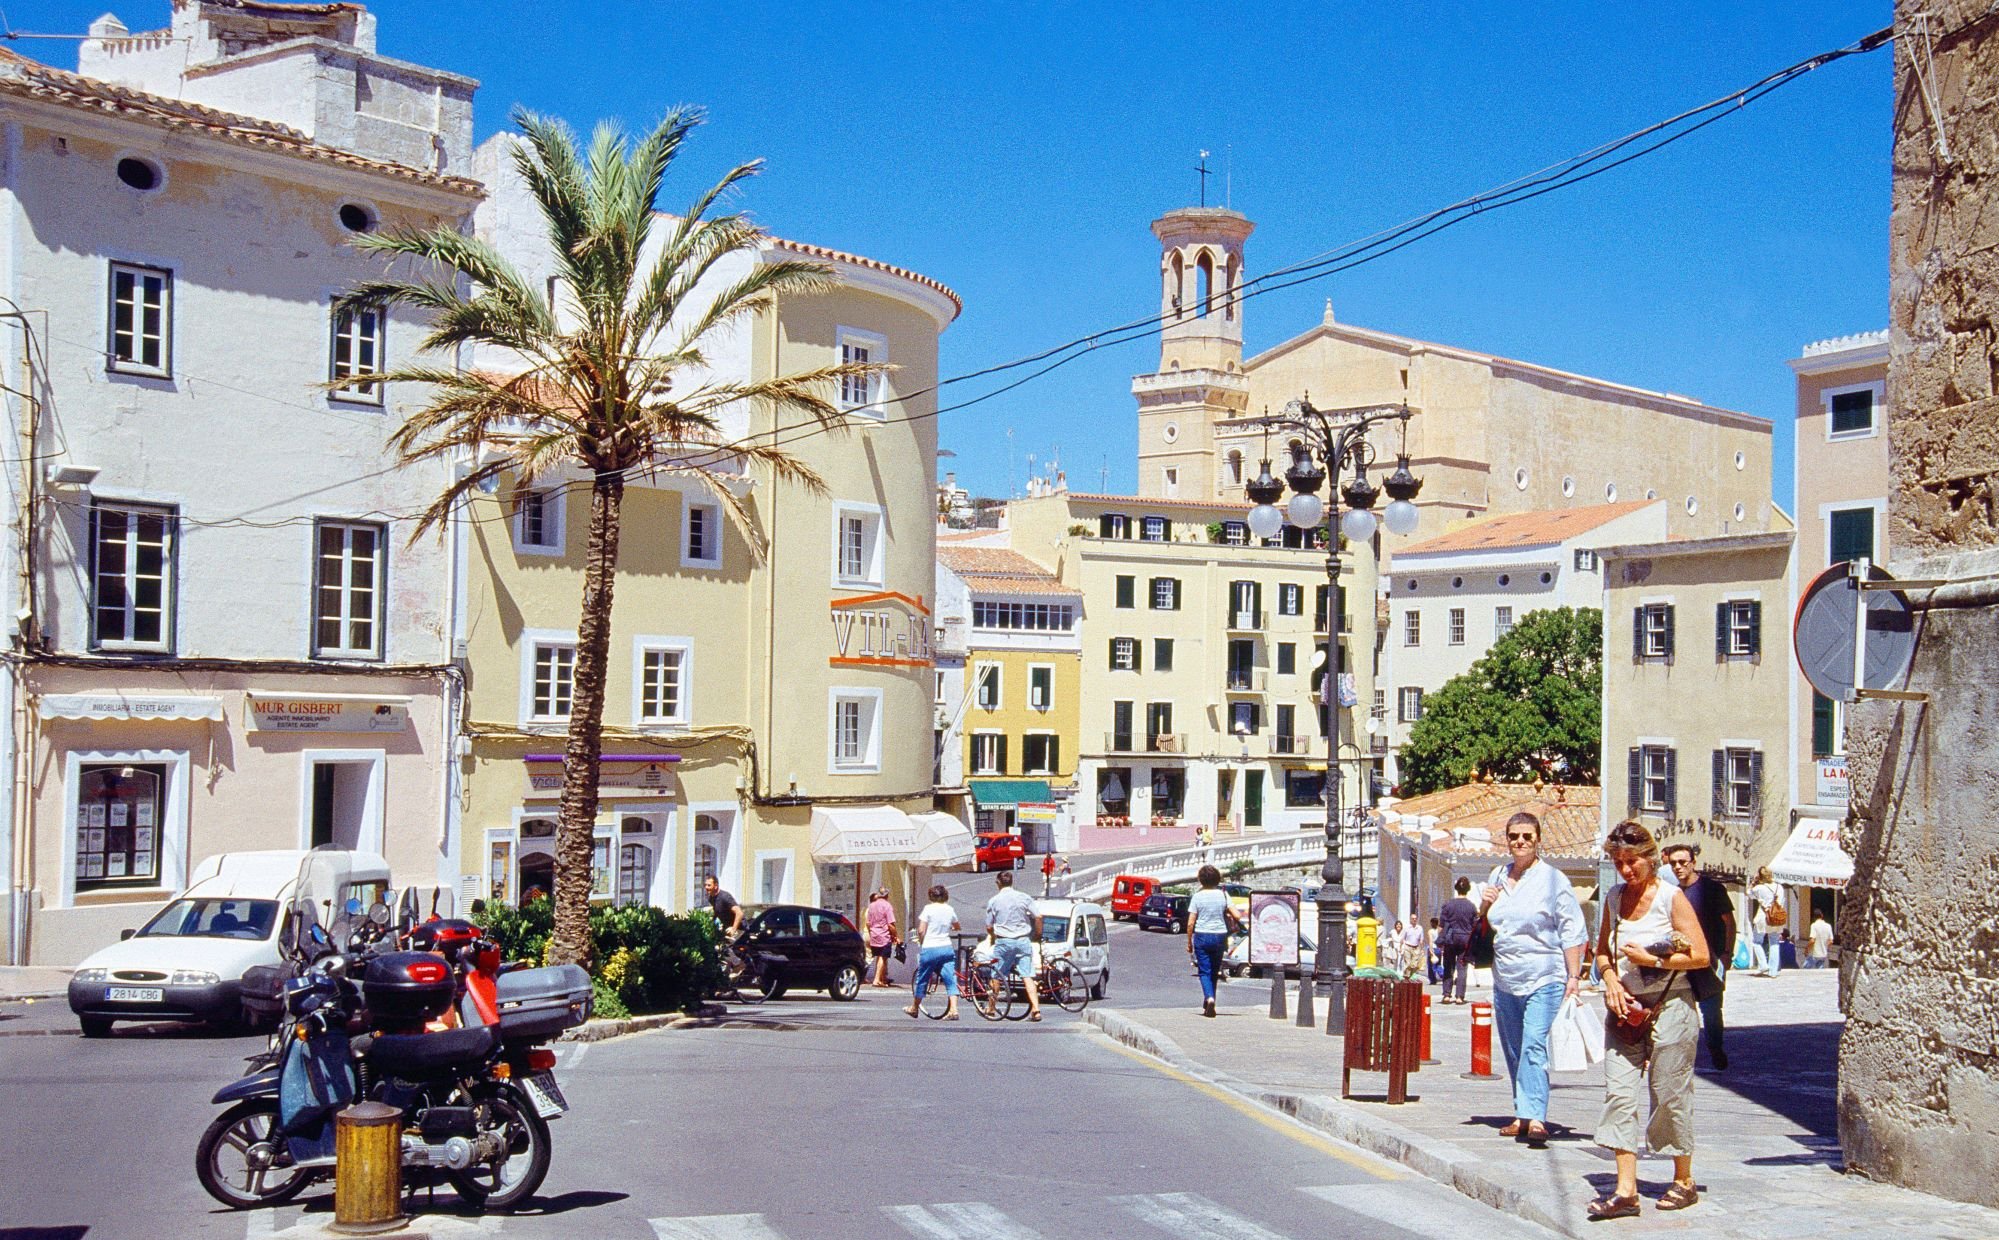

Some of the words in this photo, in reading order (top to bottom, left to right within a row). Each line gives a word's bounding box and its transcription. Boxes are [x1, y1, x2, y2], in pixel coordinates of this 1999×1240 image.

[831, 609, 930, 659] VIL-LA
[92, 704, 130, 713] INMOBILIARIA
[136, 704, 156, 713] ESTATE
[157, 704, 176, 713] AGENT
[254, 702, 285, 714] MUR
[288, 702, 344, 714] GISBERT
[1823, 768, 1837, 778] LA
[1807, 828, 1824, 840] LA
[1773, 871, 1808, 882] PANADERIA
[1812, 876, 1824, 885] LA
[113, 989, 138, 999] 2814
[140, 990, 158, 1000] CBG
